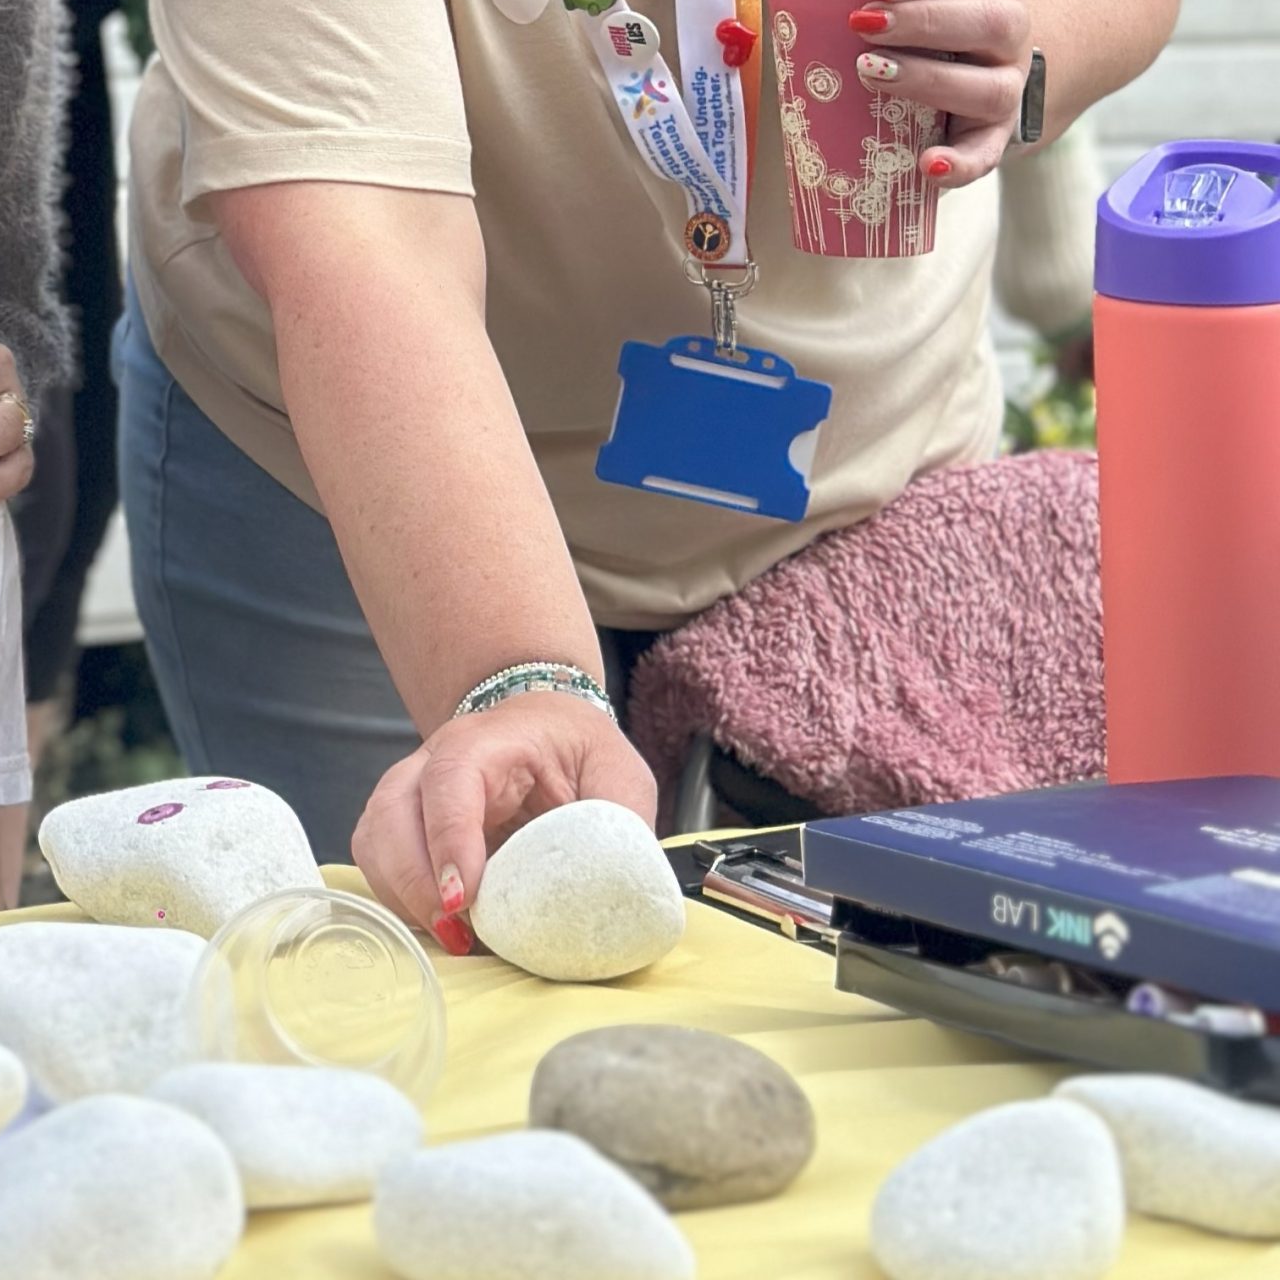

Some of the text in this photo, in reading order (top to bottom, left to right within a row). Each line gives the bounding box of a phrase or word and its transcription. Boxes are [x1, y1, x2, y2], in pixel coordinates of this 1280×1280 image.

[691, 66, 709, 127] Unedig.
[708, 73, 728, 148] Together.
[648, 120, 683, 176] Tenants
[662, 114, 712, 184] Tenantiaid
[992, 894, 1091, 947] INK LAB
